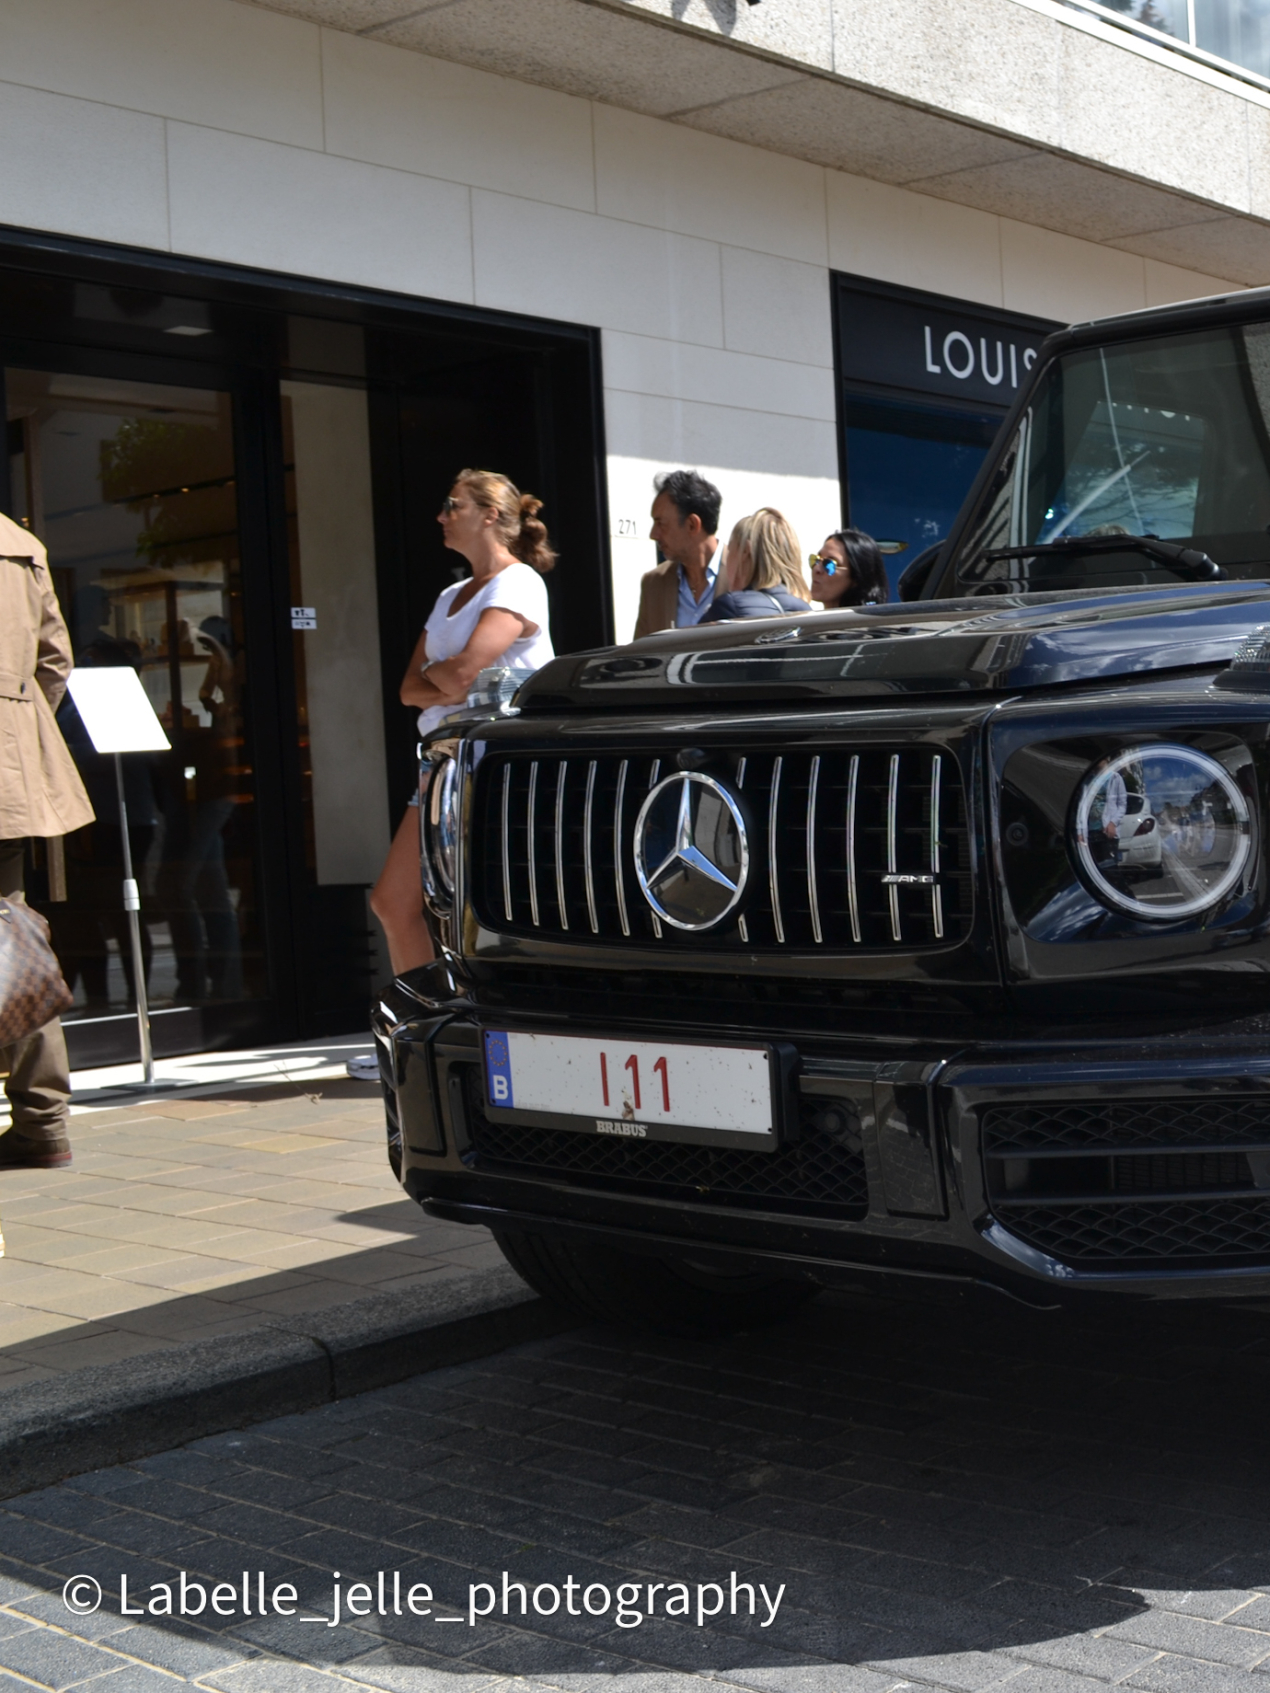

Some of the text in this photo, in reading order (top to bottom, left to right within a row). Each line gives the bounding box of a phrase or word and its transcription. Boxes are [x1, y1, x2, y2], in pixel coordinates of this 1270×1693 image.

[618, 518, 637, 535] 271
[898, 874, 934, 883] AMG
[493, 1075, 509, 1100] B
[596, 1120, 647, 1138] BRABUS
